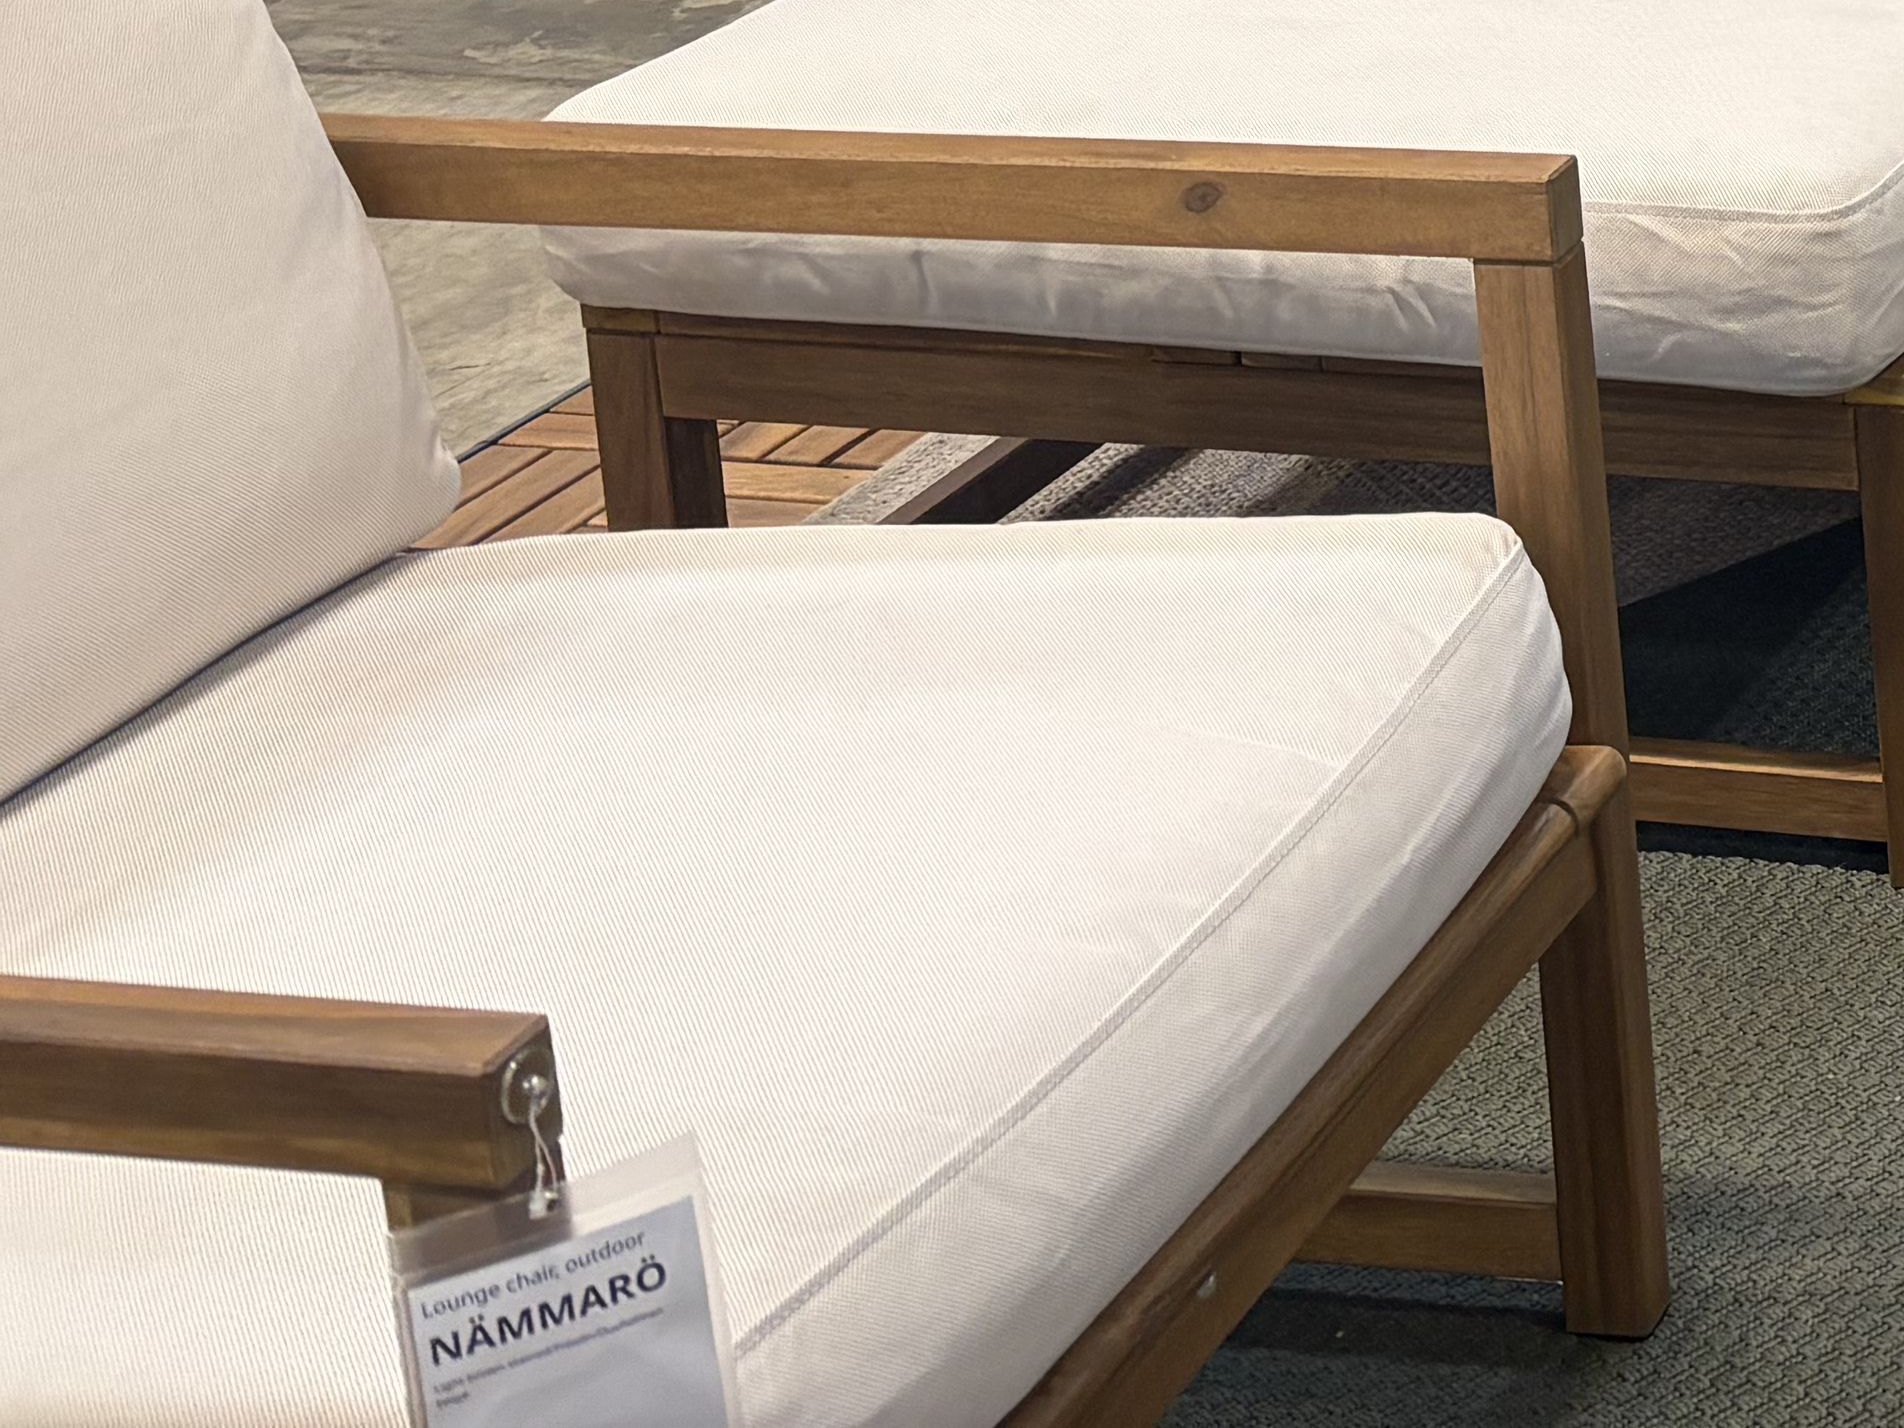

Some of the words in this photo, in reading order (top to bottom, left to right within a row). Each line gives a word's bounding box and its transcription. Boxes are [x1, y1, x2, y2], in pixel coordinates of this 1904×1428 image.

[421, 1285, 500, 1319] Lounge
[506, 1266, 560, 1294] chair,
[565, 1232, 645, 1274] outdoor
[430, 1254, 666, 1366] NÄMMARÖ
